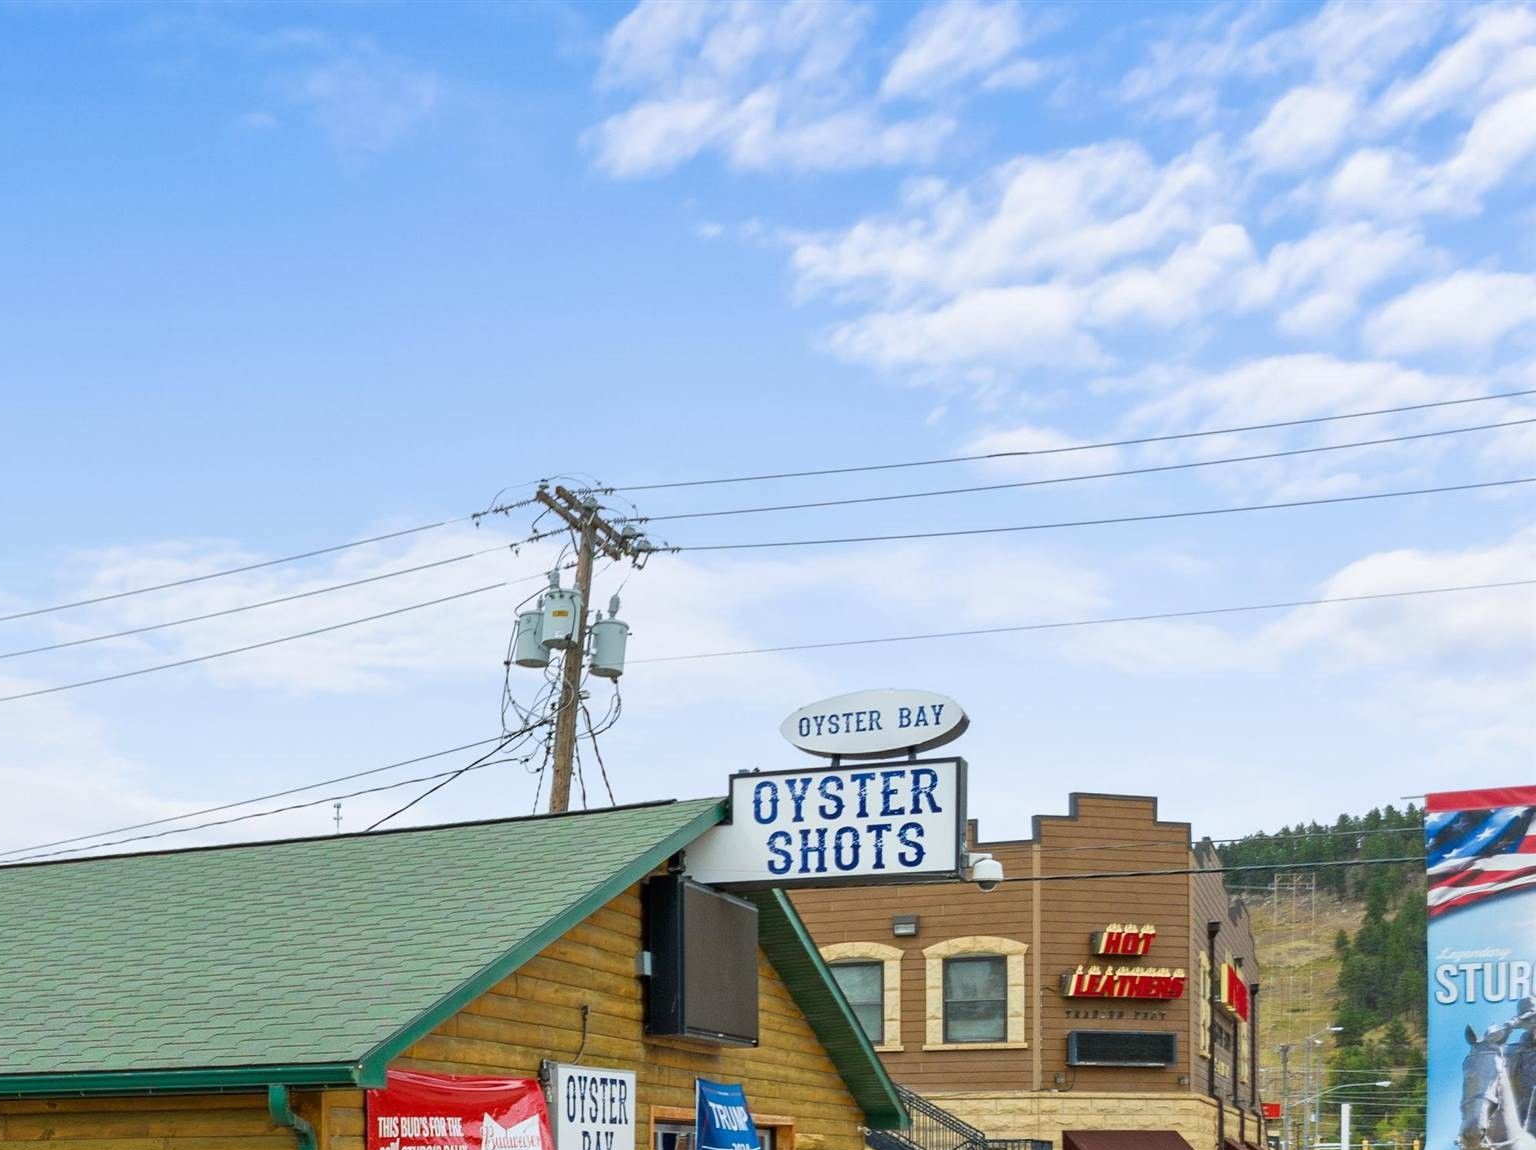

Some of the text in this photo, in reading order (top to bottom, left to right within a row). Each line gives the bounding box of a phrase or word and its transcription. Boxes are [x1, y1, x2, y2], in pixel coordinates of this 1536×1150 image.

[798, 704, 945, 737] OYSTER BAY
[752, 768, 942, 825] OYSTER
[766, 821, 926, 875] SHOTS
[1099, 923, 1157, 955] HOT
[1068, 965, 1188, 998] LEATHERS
[1435, 960, 1536, 1005] STUR
[566, 1075, 628, 1125] OYSTER
[707, 1101, 749, 1132] TRUMP
[377, 1116, 400, 1138] THIS
[429, 1116, 447, 1137] FOR
[446, 1116, 464, 1137] THE
